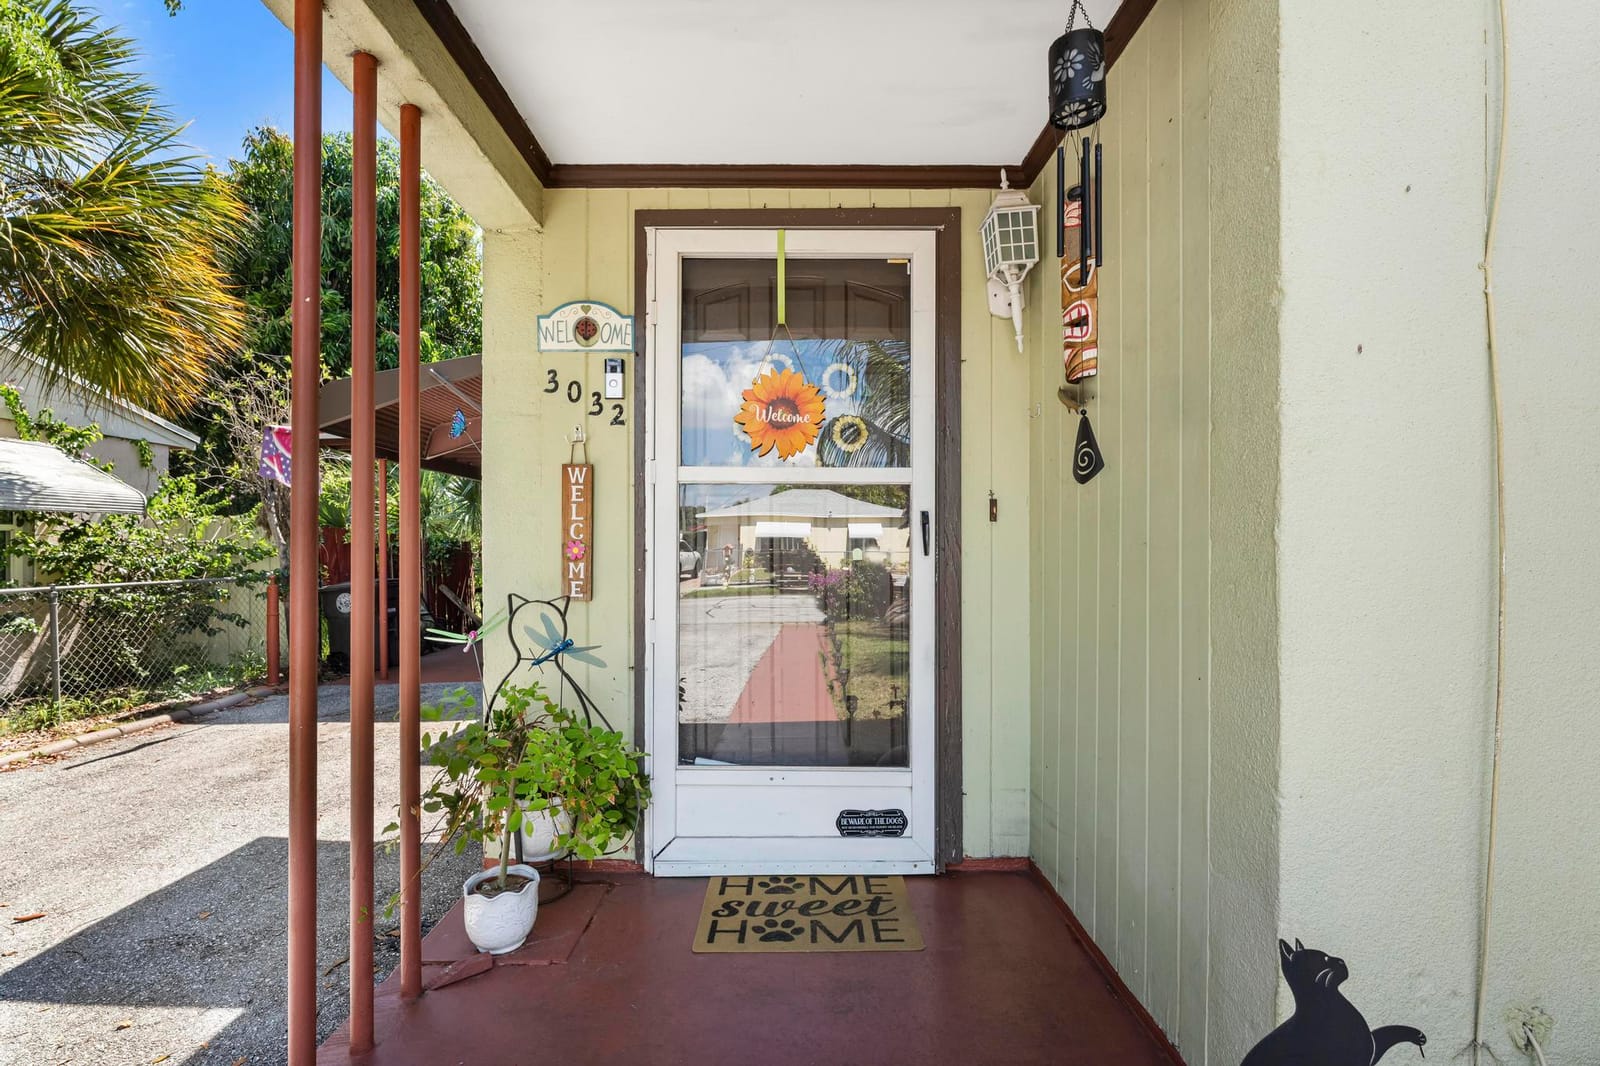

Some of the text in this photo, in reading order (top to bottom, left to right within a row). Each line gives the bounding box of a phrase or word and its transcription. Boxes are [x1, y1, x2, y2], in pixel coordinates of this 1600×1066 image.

[543, 369, 626, 426] 3032
[750, 403, 810, 424] Welcome
[567, 467, 588, 598] WELCME
[841, 817, 903, 825] BEWARE OF THE DOGS
[718, 876, 893, 896] HME
[711, 896, 896, 918] sweet
[707, 918, 905, 944] HME
